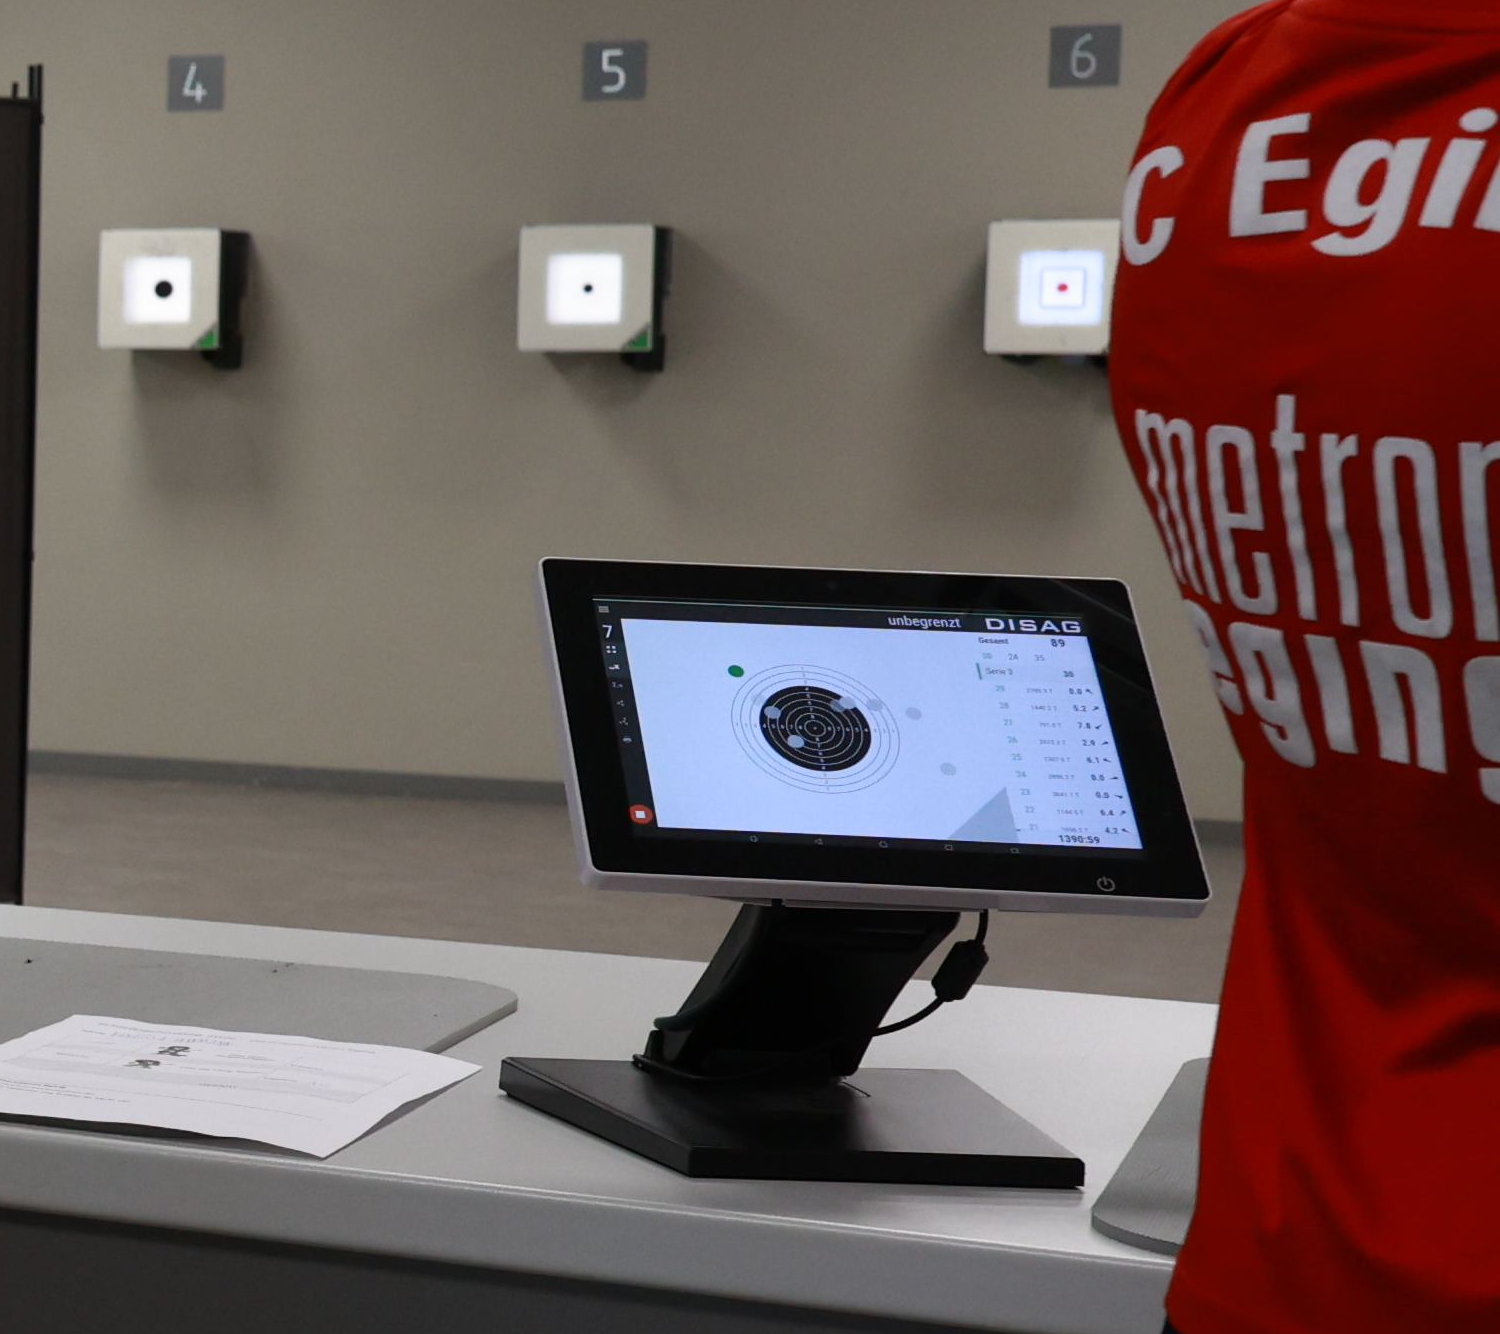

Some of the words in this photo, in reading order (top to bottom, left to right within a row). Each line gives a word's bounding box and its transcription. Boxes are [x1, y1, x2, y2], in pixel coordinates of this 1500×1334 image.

[1070, 33, 1097, 79] 6
[601, 48, 626, 93] 5
[183, 62, 208, 103] 4
[1121, 145, 1184, 266] C
[1228, 111, 1500, 257] Egi
[887, 615, 962, 629] unbegrenzt
[985, 617, 1082, 634] DISAG
[602, 624, 613, 639] 7
[1050, 638, 1066, 648] 89
[1008, 653, 1019, 661] 24
[1068, 687, 1083, 695] 0.0
[1072, 704, 1087, 712] 5.2
[1082, 739, 1096, 747] 2.9
